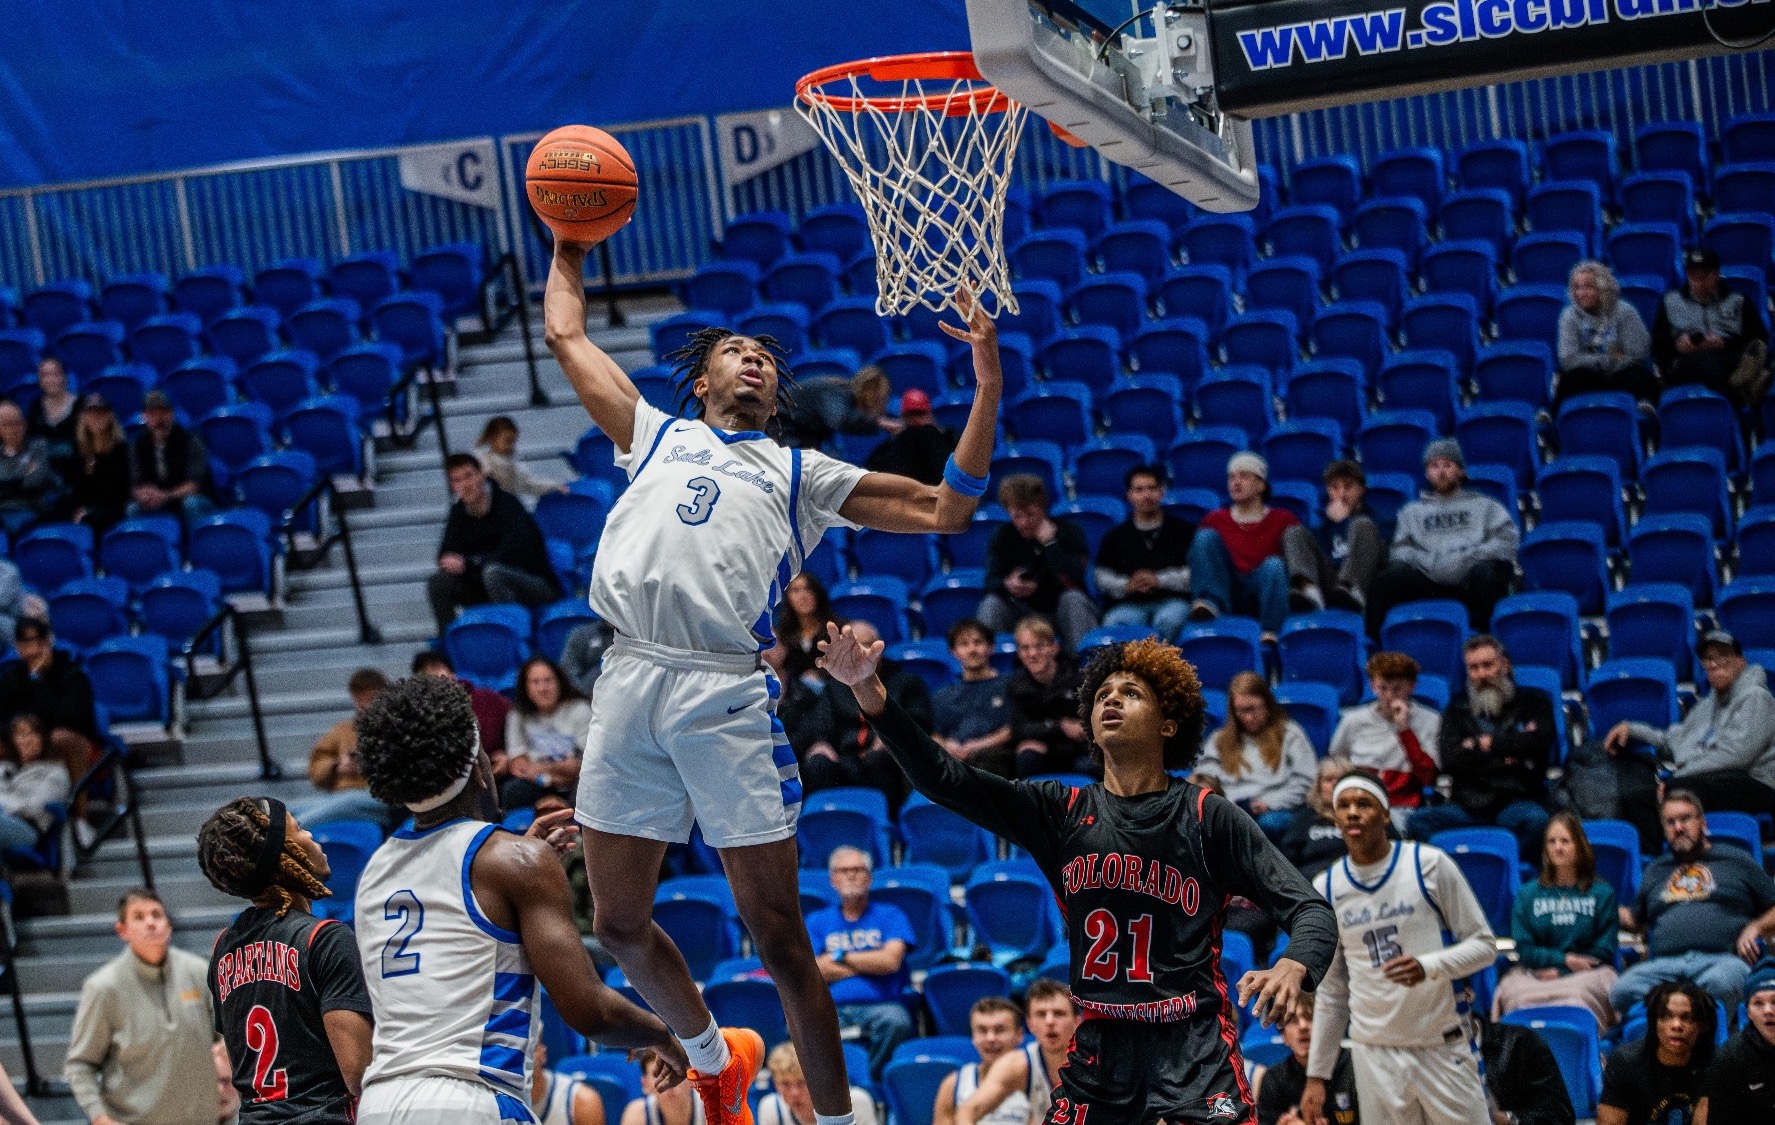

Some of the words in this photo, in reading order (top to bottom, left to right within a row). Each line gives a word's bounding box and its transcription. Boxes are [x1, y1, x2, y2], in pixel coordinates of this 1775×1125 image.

[1237, 0, 1771, 71] www.slccbr
[539, 159, 601, 174] LEGACY
[733, 124, 758, 165] D
[457, 151, 484, 192] C
[535, 185, 607, 207] SPALDING
[663, 445, 713, 466] Salt
[711, 460, 774, 494] Lake
[676, 476, 721, 526] 3
[382, 889, 425, 979] 2
[1082, 908, 1154, 984] 21
[1362, 924, 1403, 968] 15
[218, 940, 301, 1004] SPARTANS
[246, 1005, 289, 1103] 2
[1050, 1097, 1090, 1125] 21
